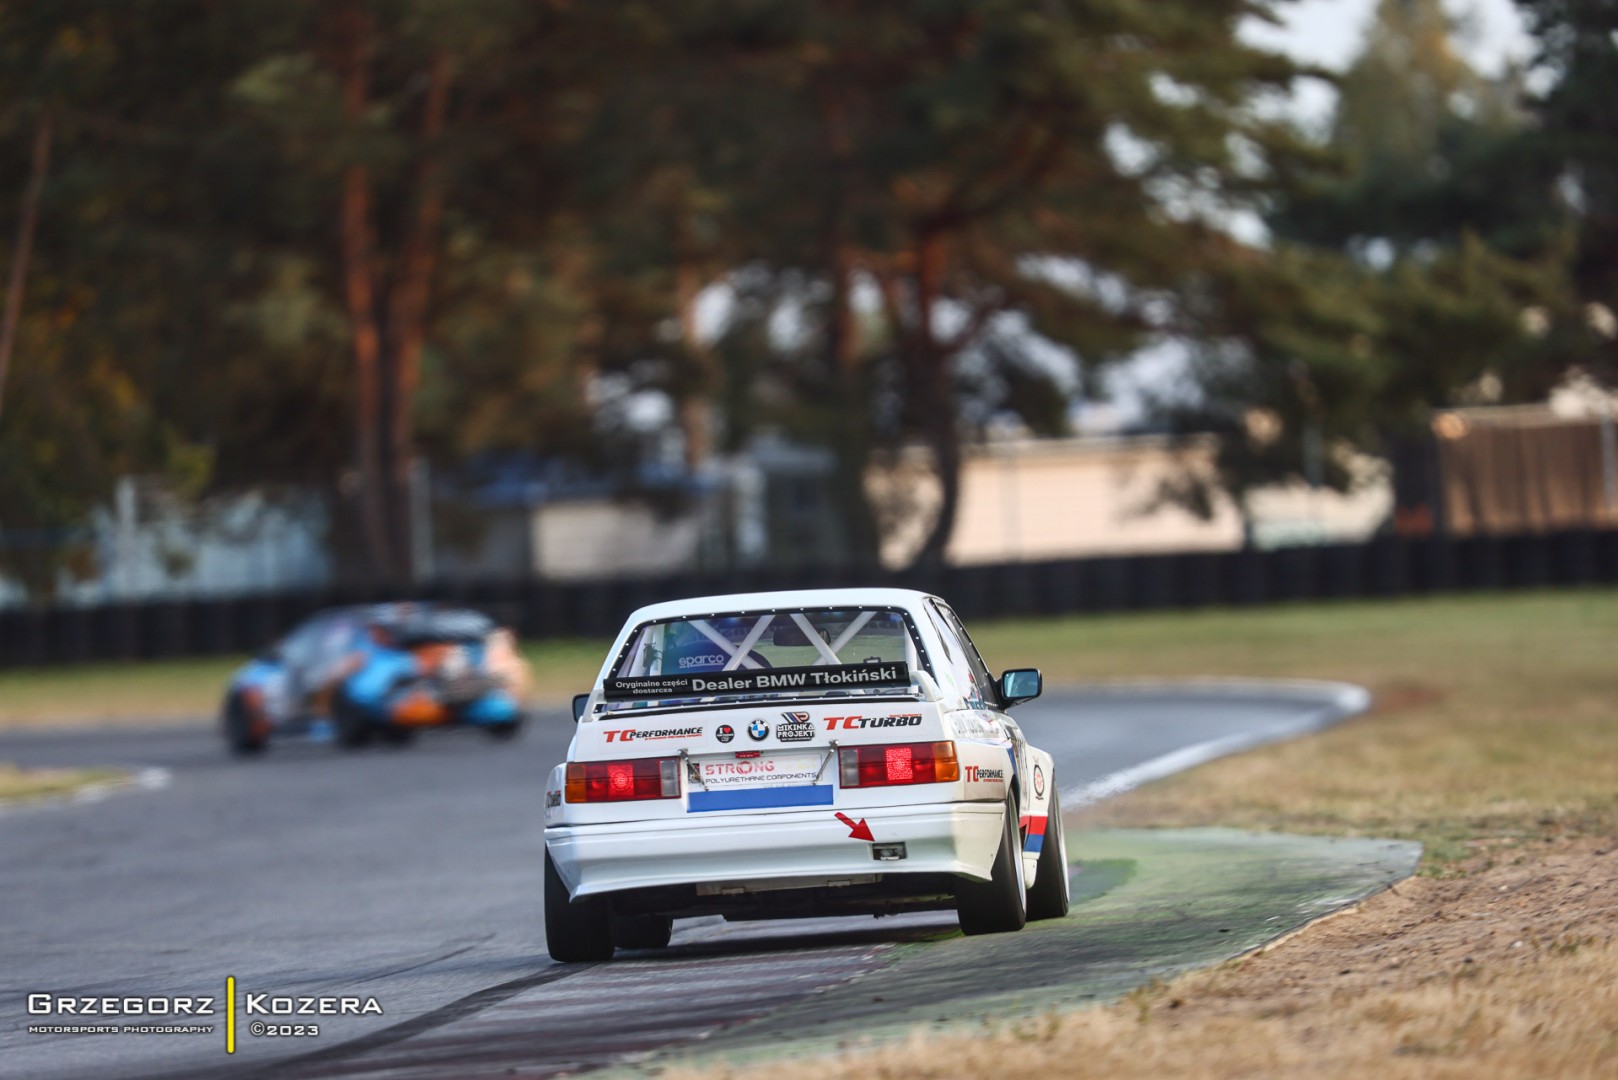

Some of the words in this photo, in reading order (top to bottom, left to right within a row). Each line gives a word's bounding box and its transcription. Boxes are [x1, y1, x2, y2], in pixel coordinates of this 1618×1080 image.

[679, 654, 724, 668] sparco
[615, 680, 660, 689] Oryginalne
[662, 679, 688, 688] części
[692, 677, 752, 692] Dealer
[757, 674, 806, 688] BMW
[811, 667, 897, 685] Tłokiński
[777, 723, 814, 731] MIKINKA
[777, 730, 814, 738] PROJEKT
[705, 760, 775, 776] STRONG
[705, 775, 766, 784] POLYURETHANE
[766, 772, 817, 781] COMPONENTS
